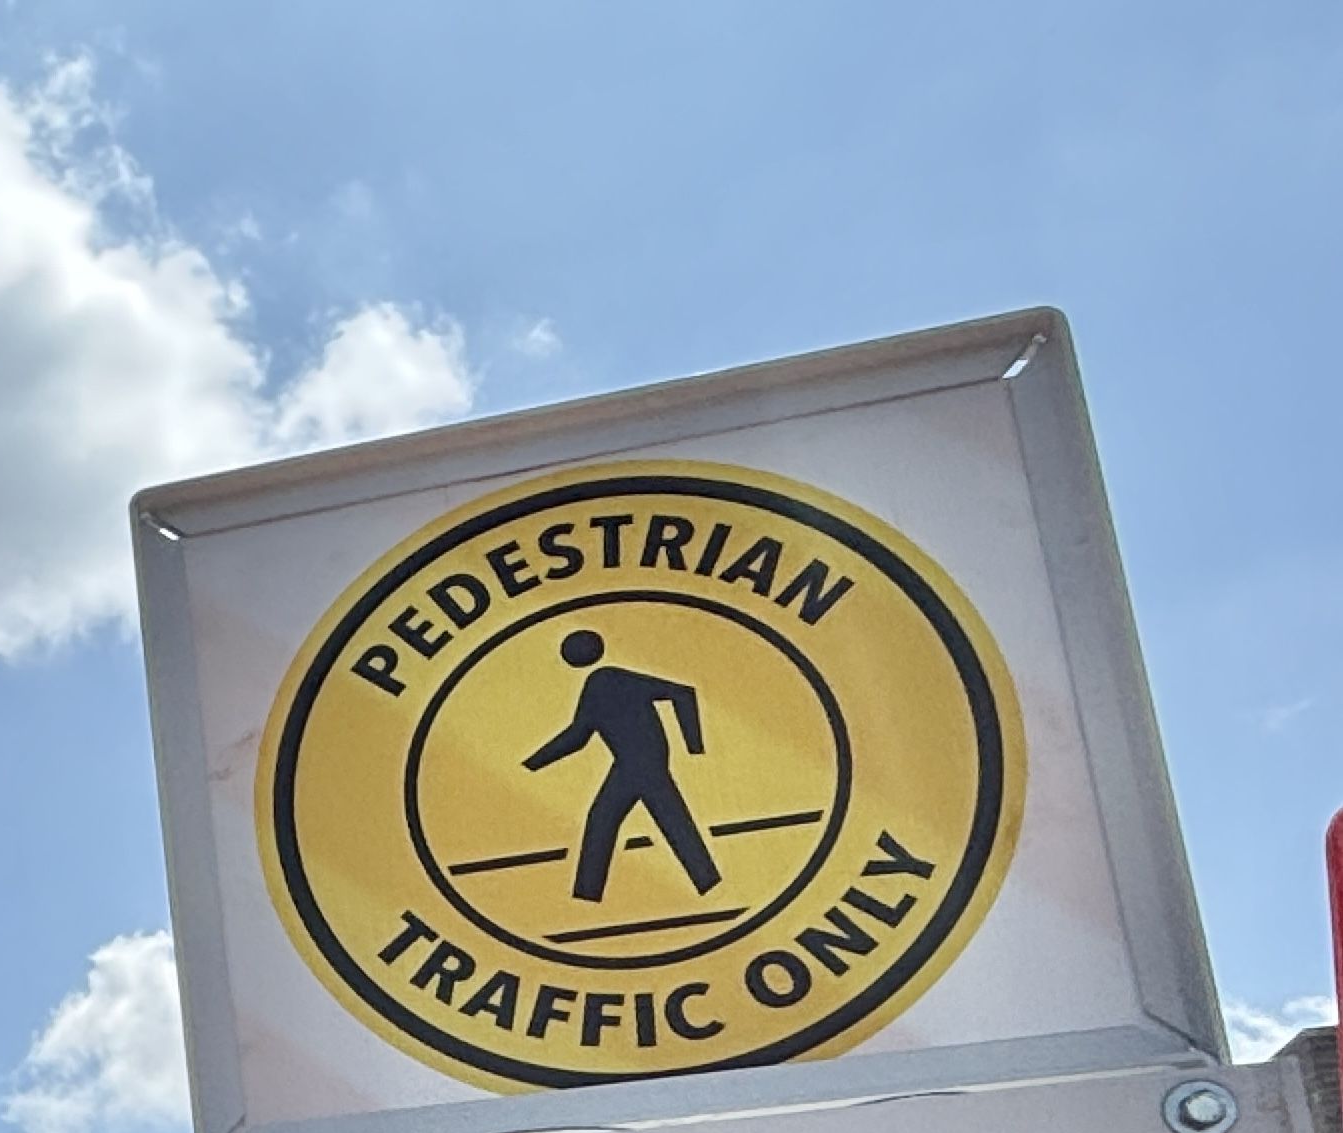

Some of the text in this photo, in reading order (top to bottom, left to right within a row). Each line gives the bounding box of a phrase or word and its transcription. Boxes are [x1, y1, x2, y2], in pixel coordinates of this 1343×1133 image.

[351, 513, 855, 698] PEDESTRIAN
[378, 830, 937, 1048] TRAFFIC ONLY
